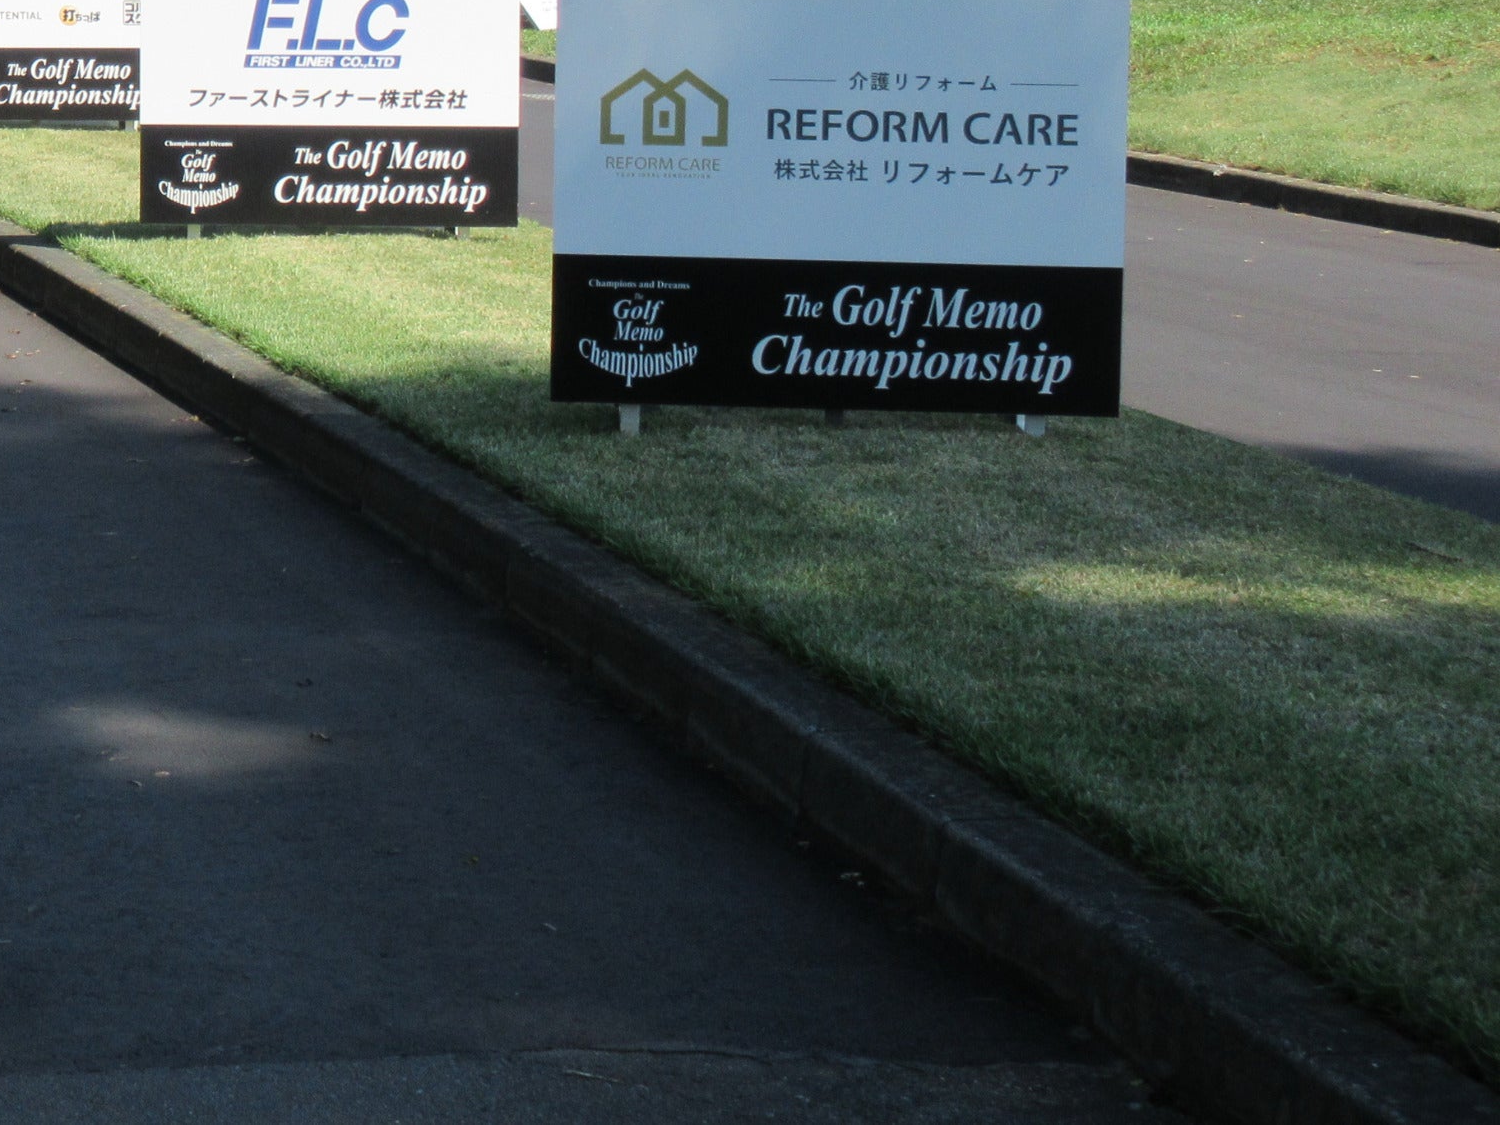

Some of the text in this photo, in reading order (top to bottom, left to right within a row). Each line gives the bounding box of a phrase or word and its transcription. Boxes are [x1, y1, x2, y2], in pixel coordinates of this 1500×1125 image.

[0, 11, 42, 21] TENTIAL
[7, 58, 132, 85] The Golf Memo
[249, 56, 396, 69] FIRST LINER CO.,LTD
[848, 71, 998, 93] 介護リフォーム
[188, 88, 469, 111] ファーストライナー株式会社
[766, 108, 1079, 147] REFORM CARE
[164, 140, 198, 148] Champions
[181, 153, 216, 172] Golf
[294, 141, 467, 177] The Golf Memo
[605, 156, 722, 172] REFORM CARE
[182, 168, 217, 183] Memo
[774, 158, 1070, 187] 株式会社 リフォームケア
[158, 180, 240, 214] Championship
[273, 175, 488, 212] Championship
[588, 278, 691, 290] Champions and Dreams
[612, 299, 665, 325] Golf
[783, 284, 1044, 338] The Golf Memo
[613, 320, 665, 342] Memo
[578, 338, 699, 388] Championship
[751, 334, 1074, 395] Championship
